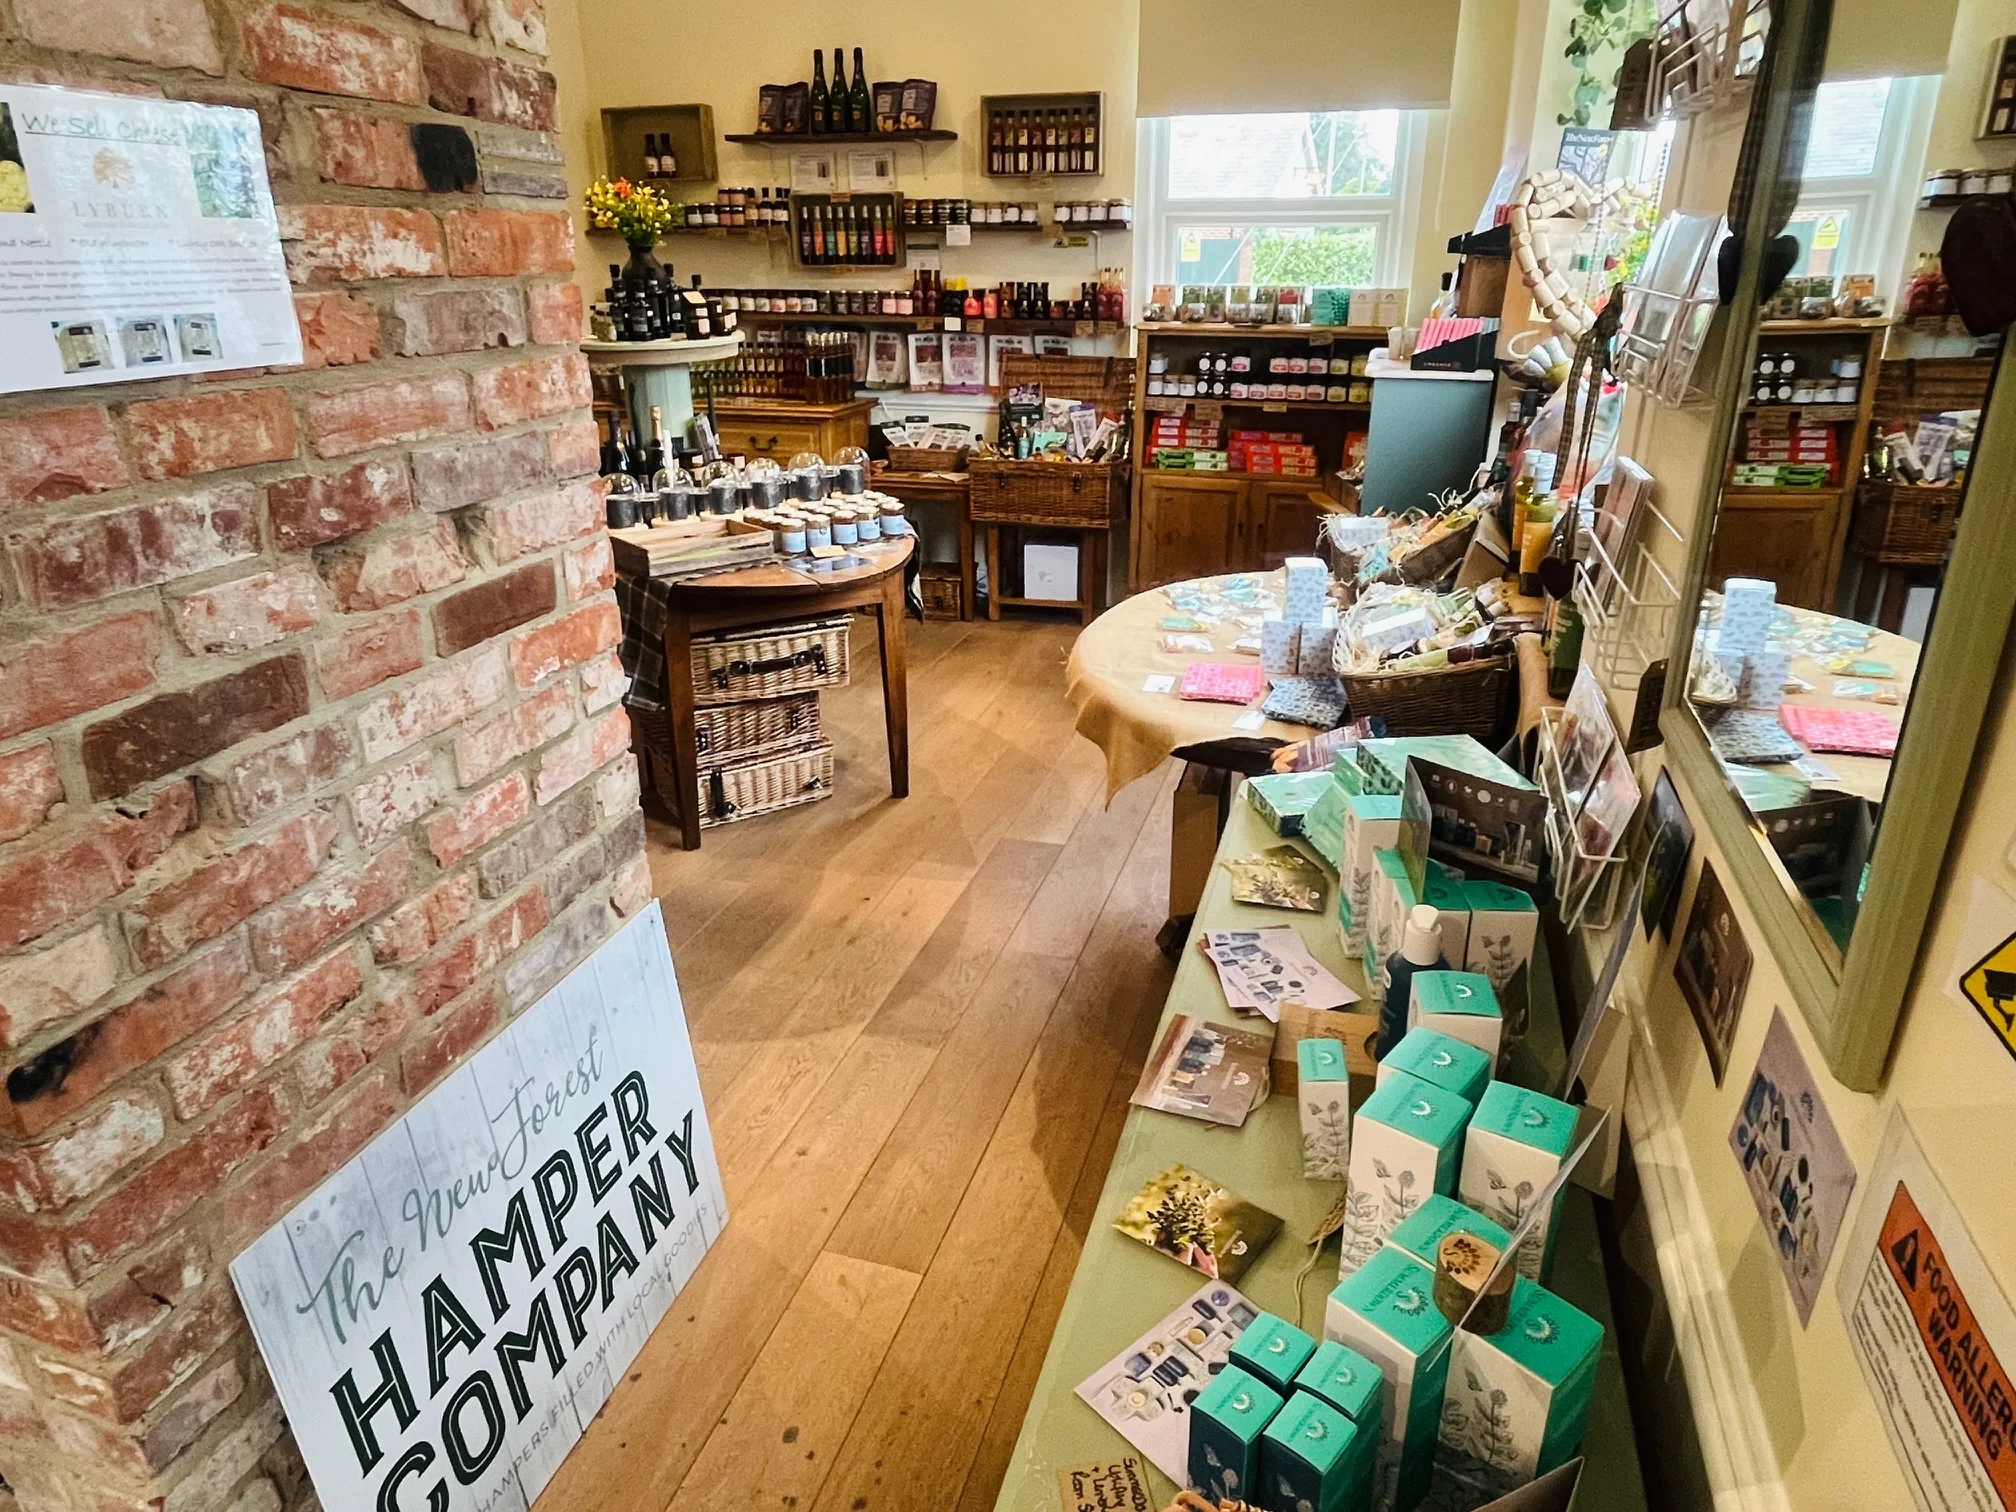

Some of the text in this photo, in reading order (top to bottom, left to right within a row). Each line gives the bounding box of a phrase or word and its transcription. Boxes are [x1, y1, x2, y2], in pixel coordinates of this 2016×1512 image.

[21, 112, 59, 135] We
[67, 116, 108, 137] Sell
[297, 1024, 604, 1345] The New Forest
[328, 1070, 658, 1478] HAMPER
[375, 1108, 701, 1512] COMPANY
[1921, 1251, 1961, 1331] FOOD
[478, 1420, 550, 1512] HAMPERS
[551, 1360, 595, 1428] FILLED
[627, 1267, 667, 1320] LOCAL
[663, 1203, 708, 1269] GOODIES
[1928, 1306, 2002, 1462] WARNING
